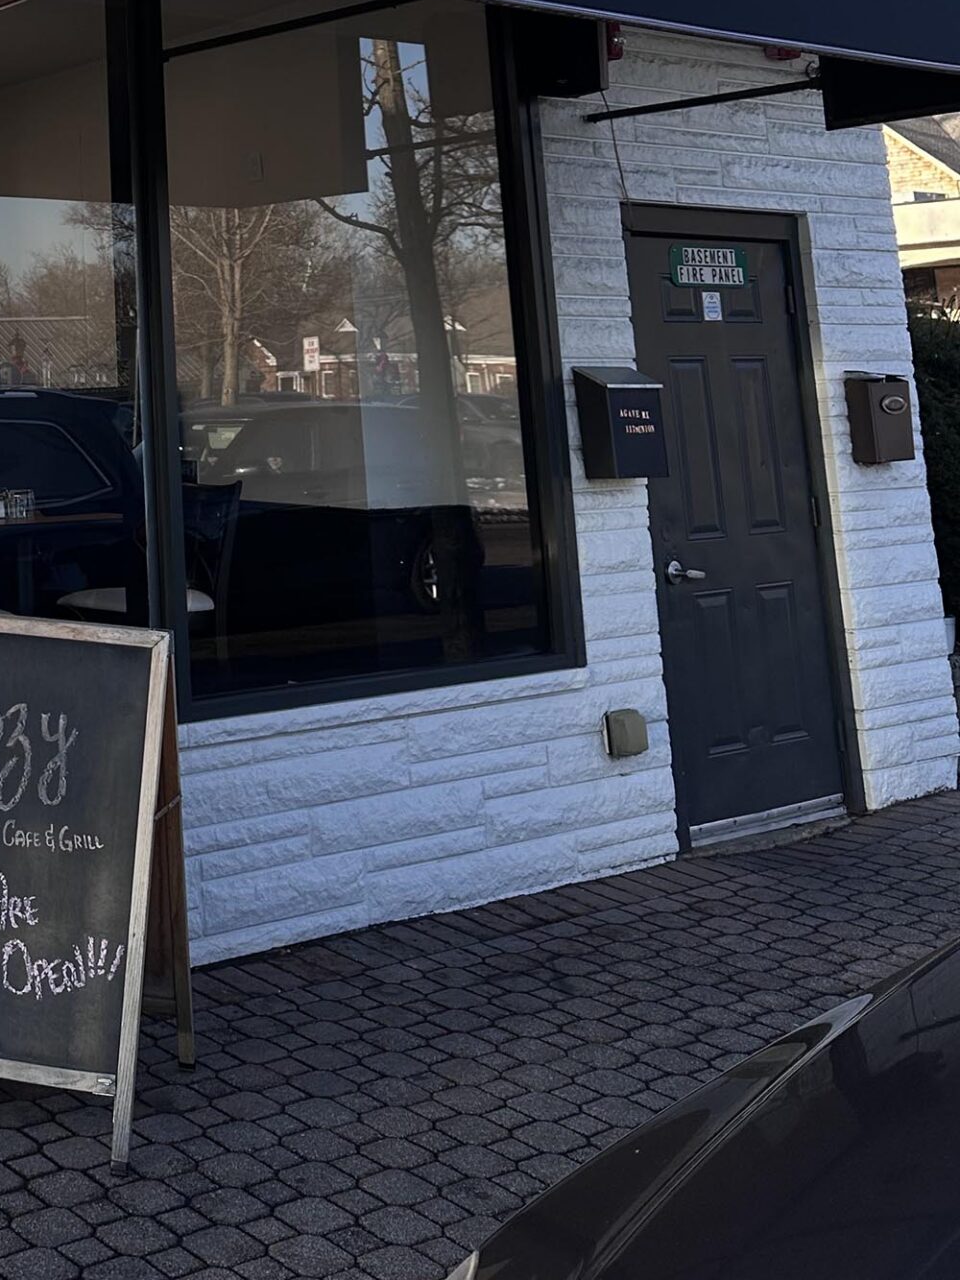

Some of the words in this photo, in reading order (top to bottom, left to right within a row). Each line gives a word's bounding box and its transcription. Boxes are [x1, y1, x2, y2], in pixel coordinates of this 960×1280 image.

[683, 248, 735, 265] BASEMENT
[679, 267, 705, 282] FIRE
[711, 268, 743, 284] PANEL
[45, 823, 56, 853] &
